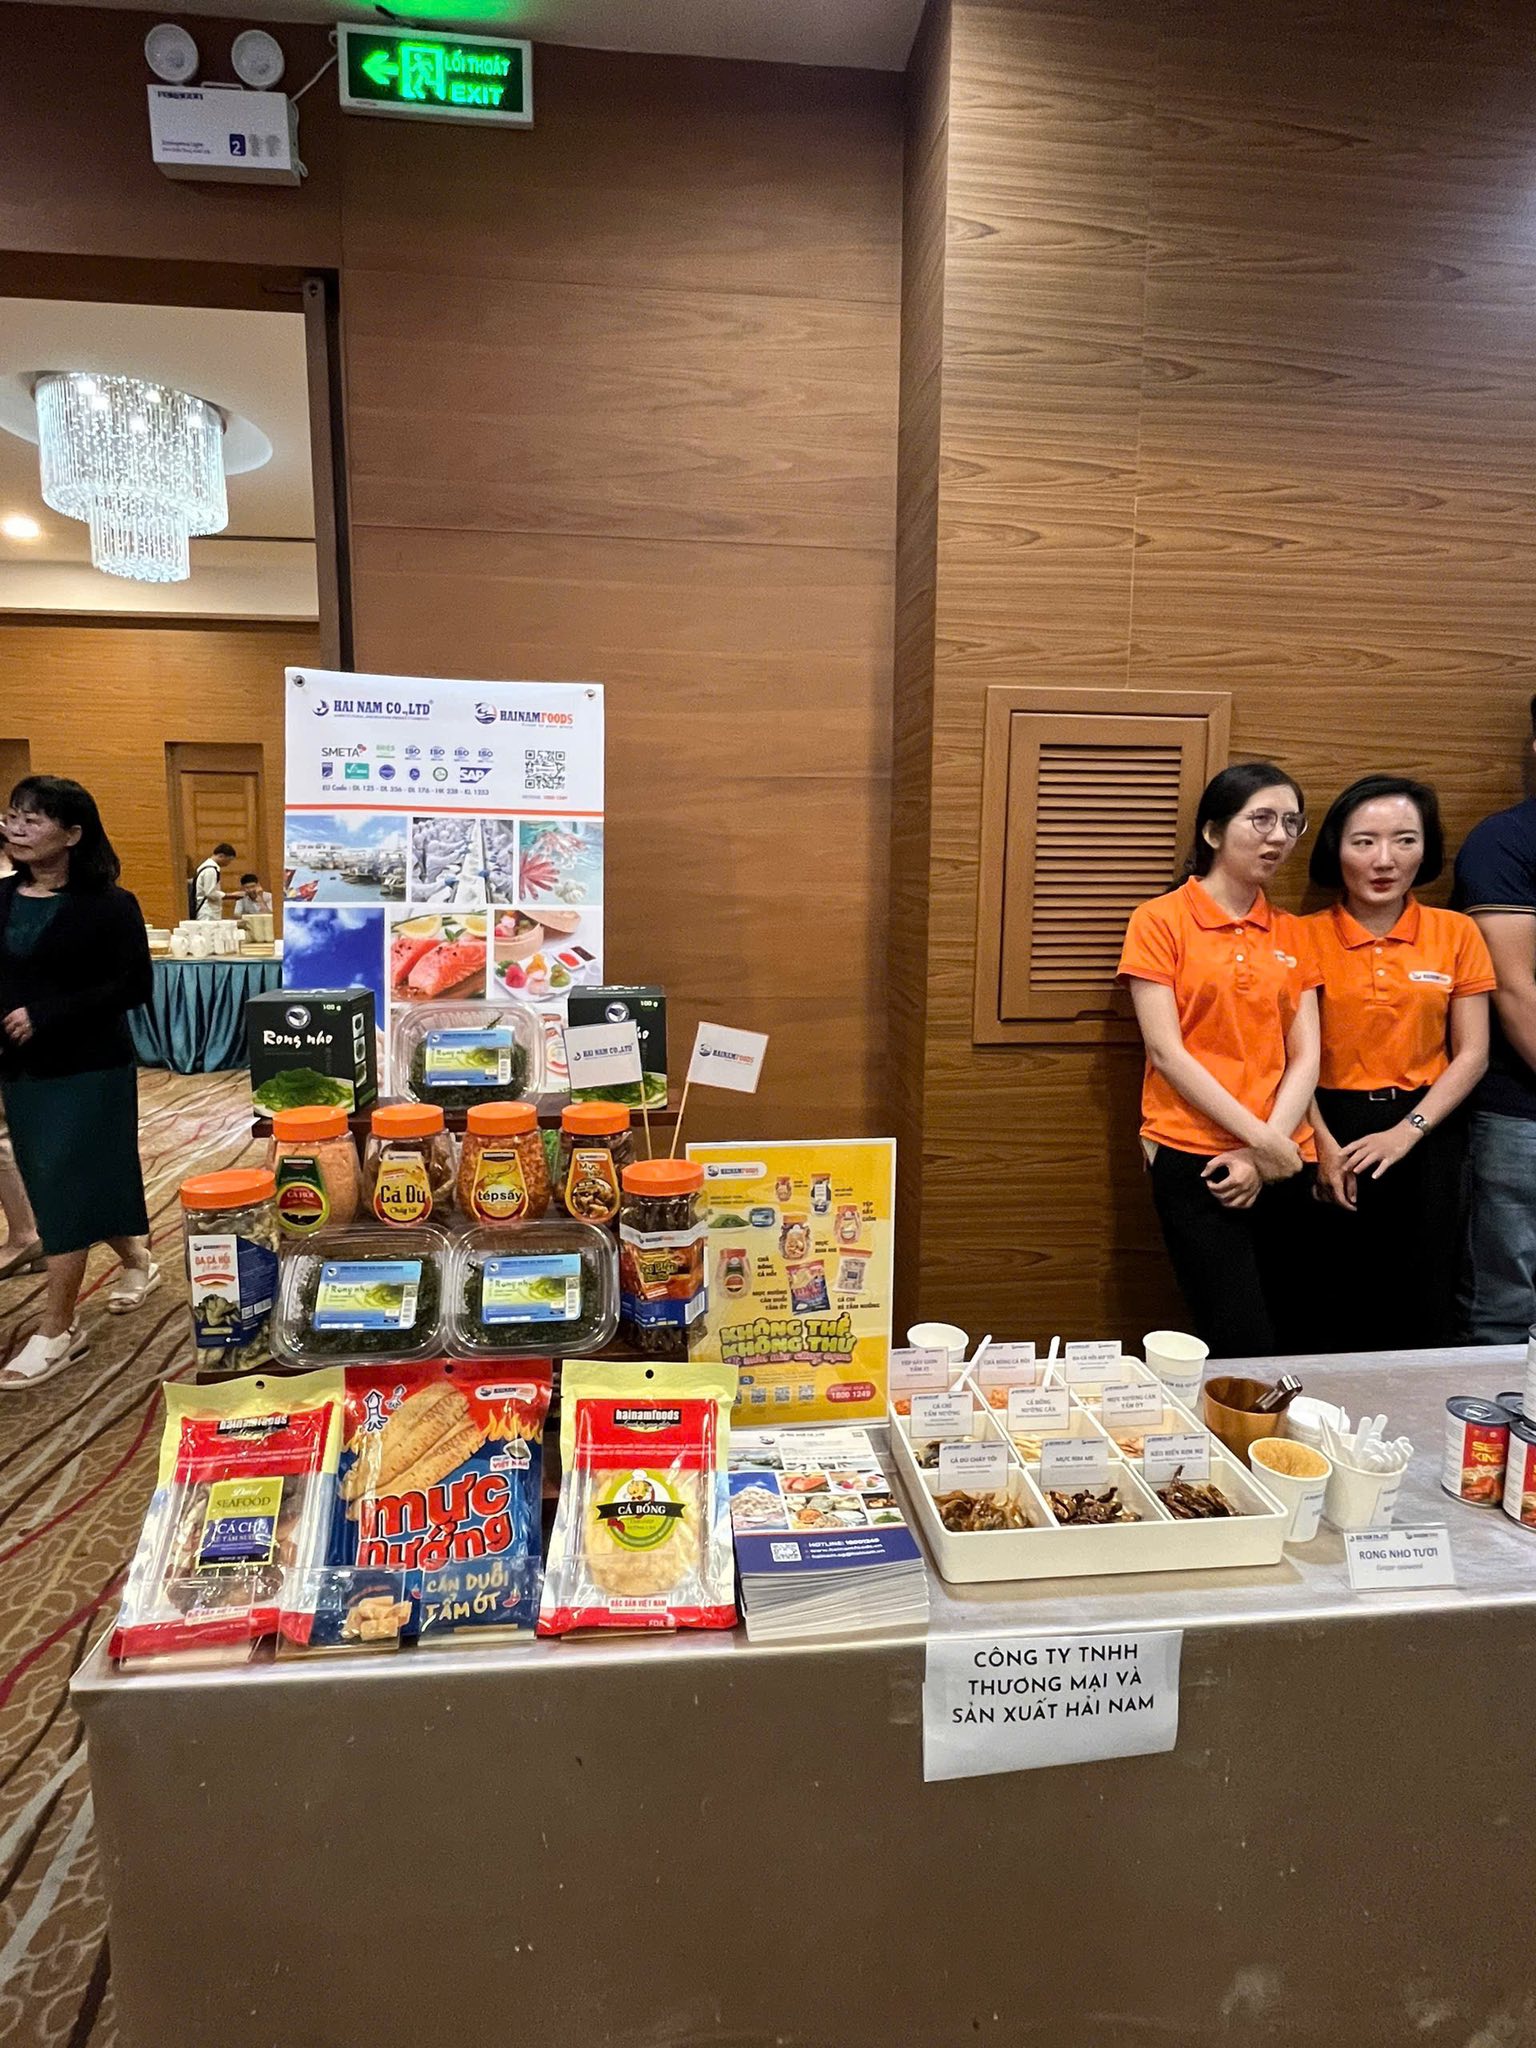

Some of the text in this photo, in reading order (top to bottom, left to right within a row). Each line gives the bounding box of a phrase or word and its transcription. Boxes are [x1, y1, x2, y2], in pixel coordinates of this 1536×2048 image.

[467, 54, 511, 77] THOÁT
[451, 82, 504, 107] EXIT
[231, 140, 242, 155] 2
[333, 699, 354, 713] HAI
[356, 701, 383, 714] NAM
[499, 709, 574, 726] HAINAMFOODS
[321, 747, 361, 758] SMETA
[460, 769, 486, 782] SAP
[263, 1029, 334, 1049] Rong nho
[380, 1184, 401, 1204] Cá
[720, 1312, 851, 1343] KHÔNG THỂ
[721, 1332, 857, 1358] KHÔNG THỬ
[615, 1409, 681, 1421] hainamfoods
[216, 1496, 272, 1509] SEAFOOD
[359, 1472, 511, 1541] mực
[617, 1503, 633, 1515] CÁ
[217, 1520, 236, 1535] CÁ
[356, 1512, 513, 1573] nướng
[1359, 1549, 1387, 1560] RONG
[1389, 1548, 1412, 1559] NHO
[974, 1643, 1138, 1668] CÔNG TY TNHH
[968, 1666, 1142, 1696] THƯƠNG MẠI VÀ
[952, 1695, 1154, 1724] SẢN XUẤT HẢI NAM
